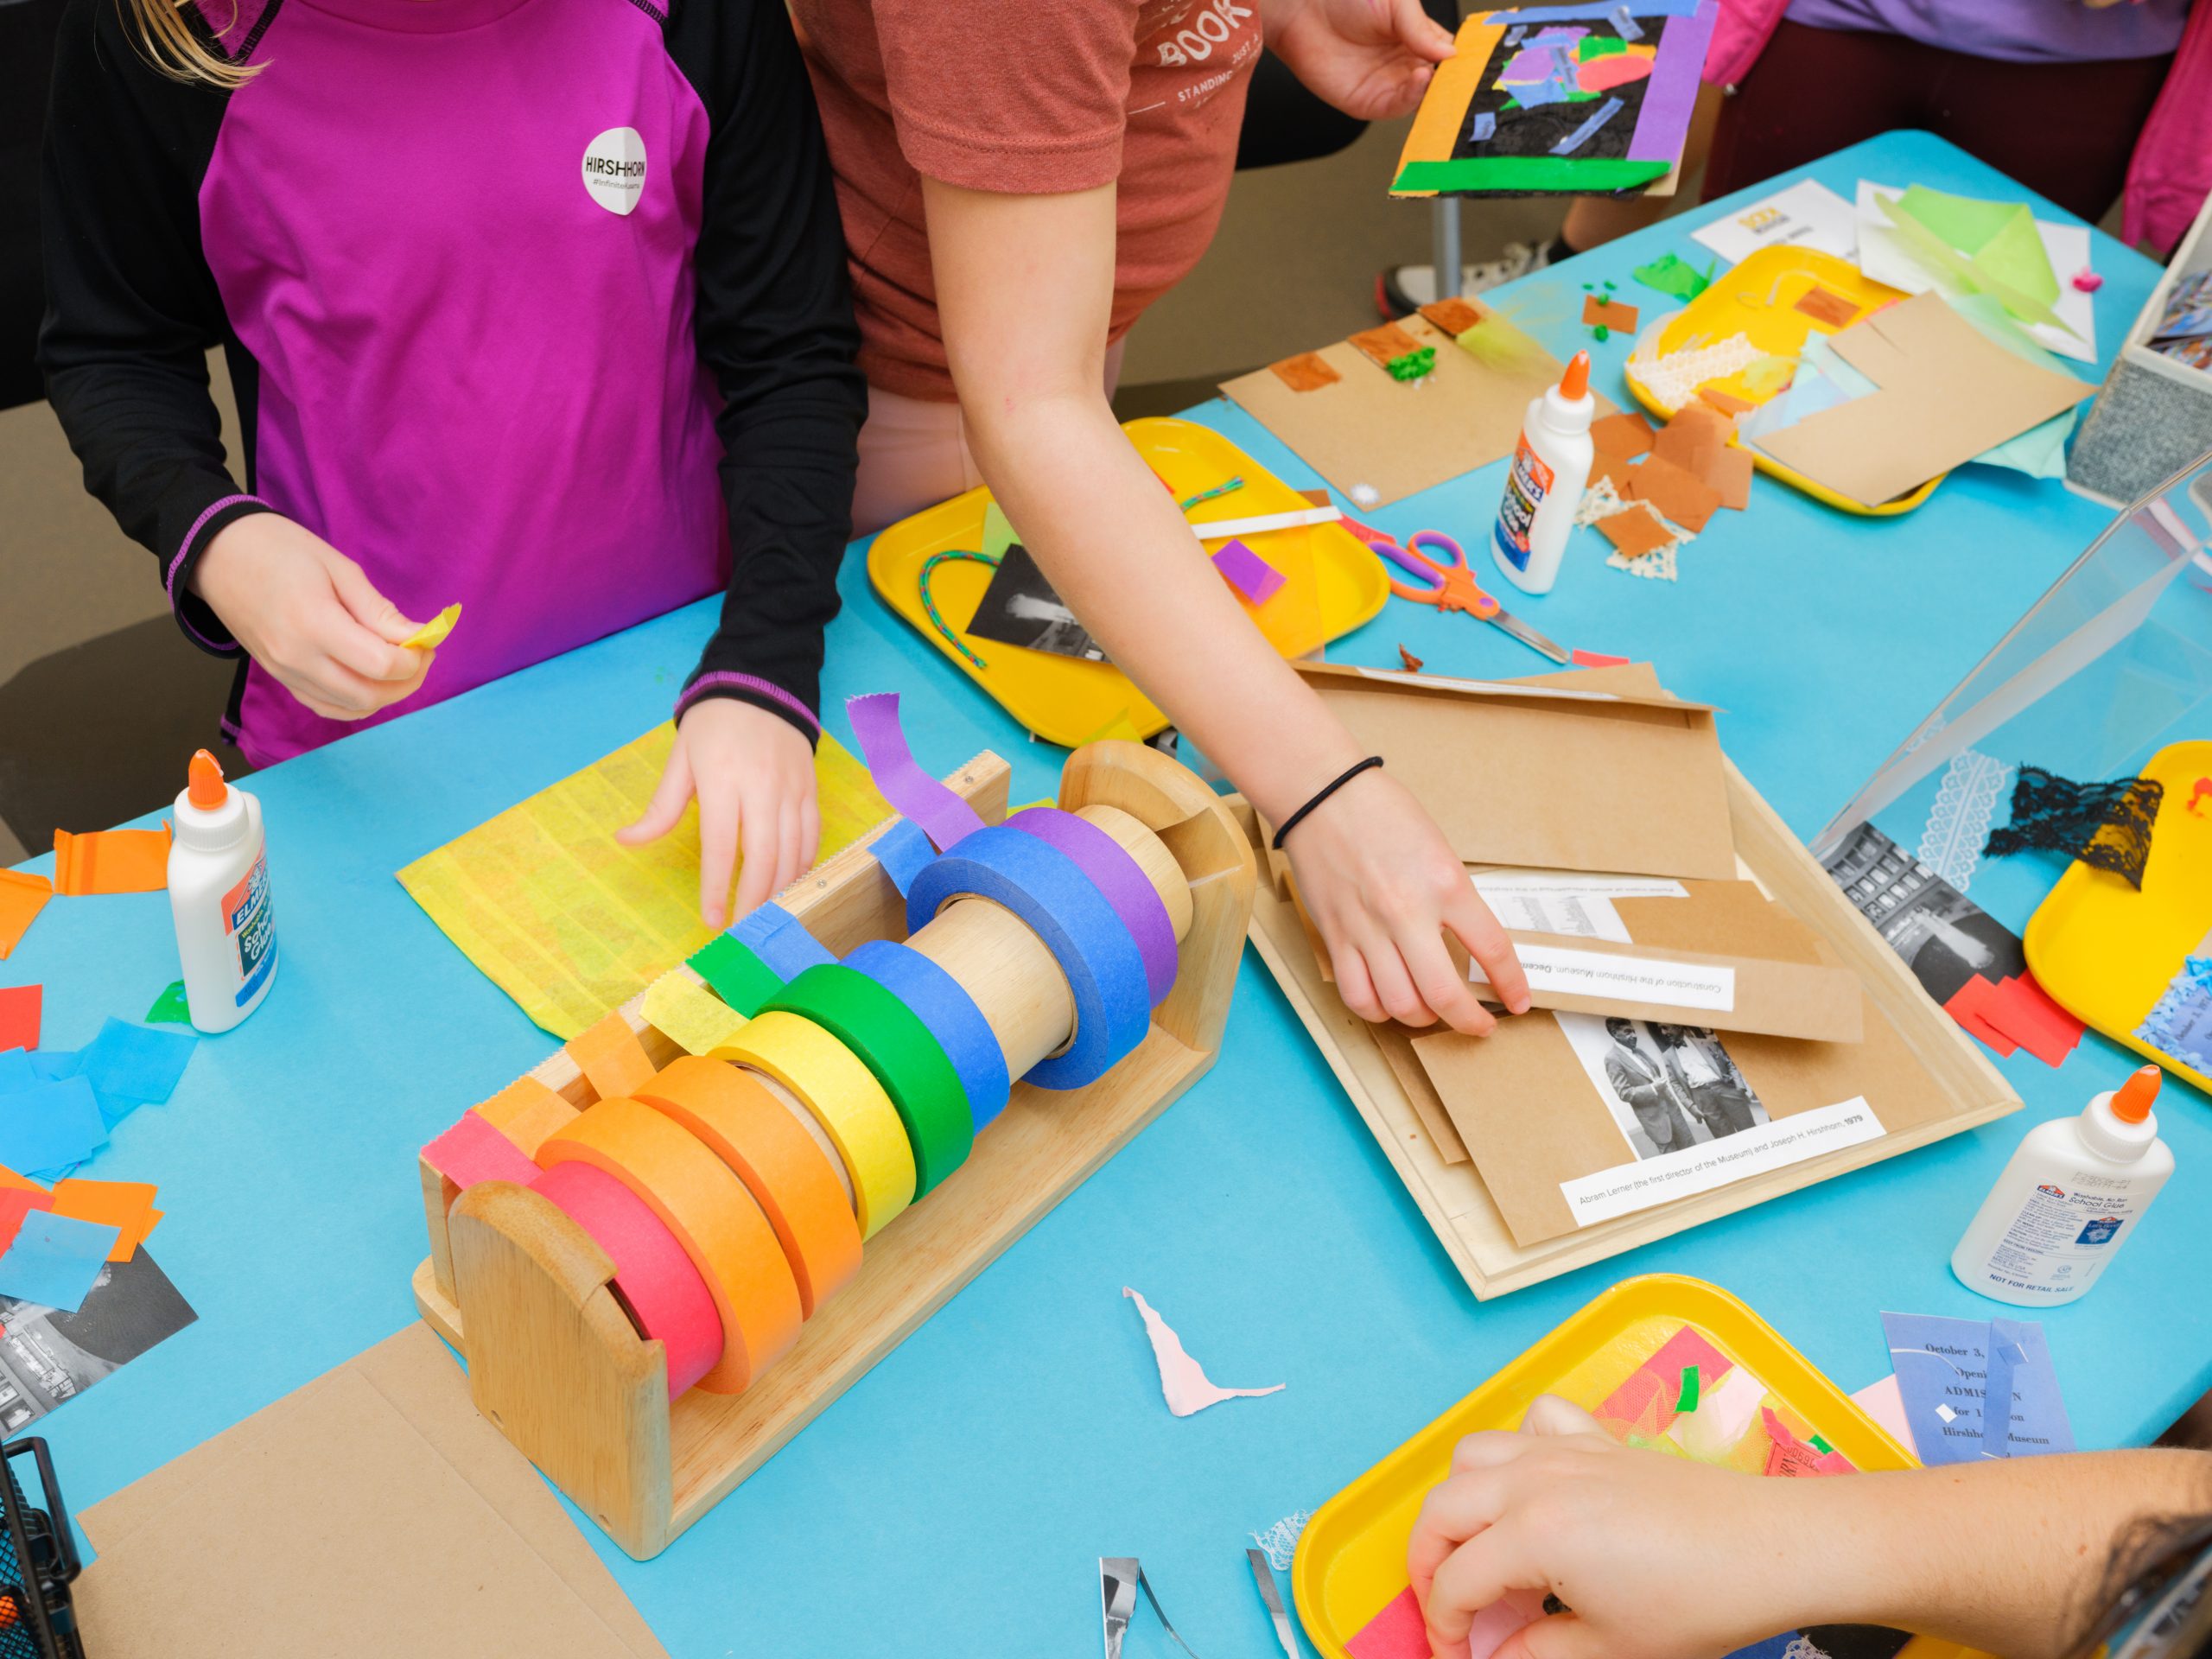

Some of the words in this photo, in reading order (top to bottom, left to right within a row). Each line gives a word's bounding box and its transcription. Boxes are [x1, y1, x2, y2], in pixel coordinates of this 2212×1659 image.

[1157, 0, 1253, 67] BOOK
[586, 156, 645, 178] HIRSHHORN
[245, 899, 272, 954] Schoo
[1521, 962, 1552, 974] Decem
[1596, 970, 1637, 984] Hirshhorn
[1639, 976, 1653, 986] the
[1655, 978, 1664, 987] of
[1667, 980, 1721, 994] Construction
[1580, 1192, 1606, 1205] Abram
[1607, 1183, 1633, 1197] Lerner
[1634, 1178, 1649, 1191] (the
[1649, 1173, 1664, 1185] first
[1665, 1166, 1693, 1181] director
[1694, 1163, 1704, 1172] of
[1704, 1159, 1717, 1169] the
[1717, 1147, 1754, 1164] Museum)
[1754, 1142, 1769, 1154] and
[1770, 1135, 1797, 1149] Joseph
[1797, 1131, 1806, 1140] H.
[1844, 1114, 1864, 1127] 1979
[2069, 1197, 2103, 1208] School
[1989, 1274, 2007, 1284] NOT
[2007, 1280, 2024, 1288] FOR
[2025, 1284, 2052, 1293] RETAIL
[1925, 1343, 1968, 1356] October
[1973, 1348, 1986, 1359] 3,
[1955, 1367, 1986, 1380] Openi
[1954, 1406, 1970, 1416] for
